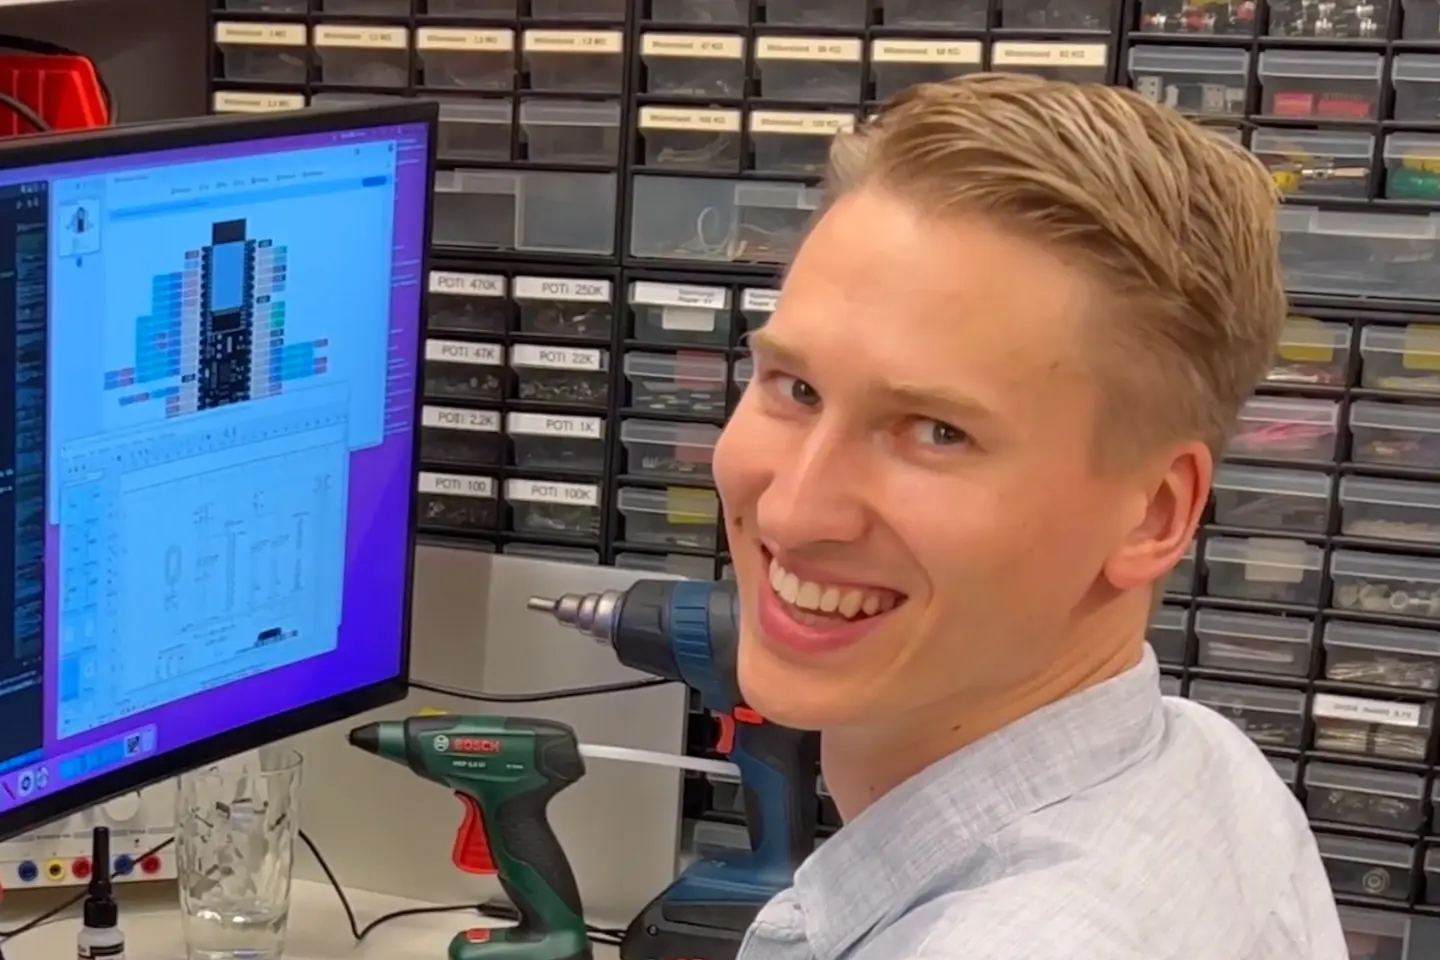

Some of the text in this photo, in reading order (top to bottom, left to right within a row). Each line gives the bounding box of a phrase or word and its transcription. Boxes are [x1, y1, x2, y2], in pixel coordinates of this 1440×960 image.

[437, 275, 497, 291] POTI 470K
[542, 282, 604, 296] POTI 250K
[441, 345, 496, 360] POTI 47K
[539, 350, 594, 365] POTI 22K
[546, 419, 596, 433] POTI 1K
[435, 477, 487, 492] POTI 100
[531, 485, 593, 500] POTI 100K
[454, 738, 501, 753] BOSCH
